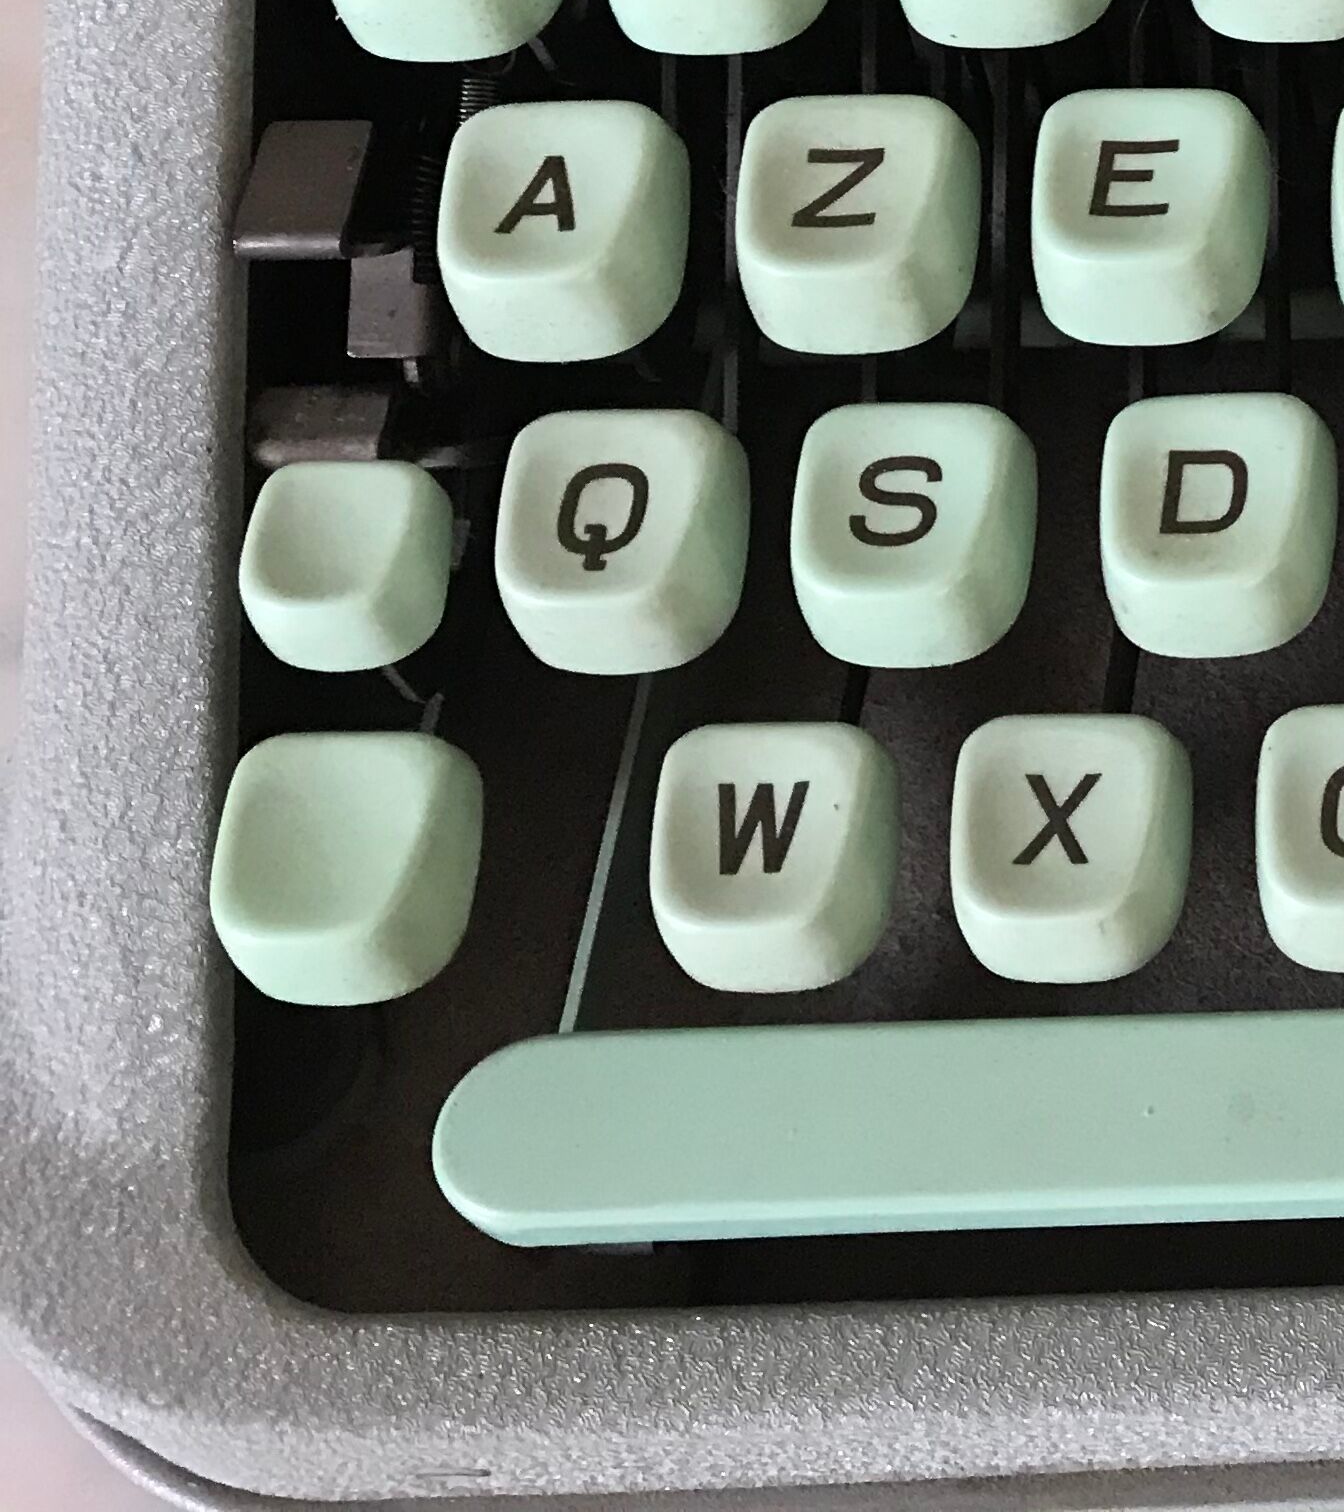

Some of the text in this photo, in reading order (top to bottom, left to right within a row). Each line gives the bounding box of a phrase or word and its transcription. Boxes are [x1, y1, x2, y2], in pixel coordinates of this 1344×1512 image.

[492, 155, 576, 235] A
[790, 147, 886, 229] Z
[1087, 139, 1180, 218] E
[556, 462, 649, 572] Q
[848, 455, 943, 548] S
[1158, 449, 1249, 536] D
[717, 780, 810, 877] W
[1011, 772, 1103, 866] X
